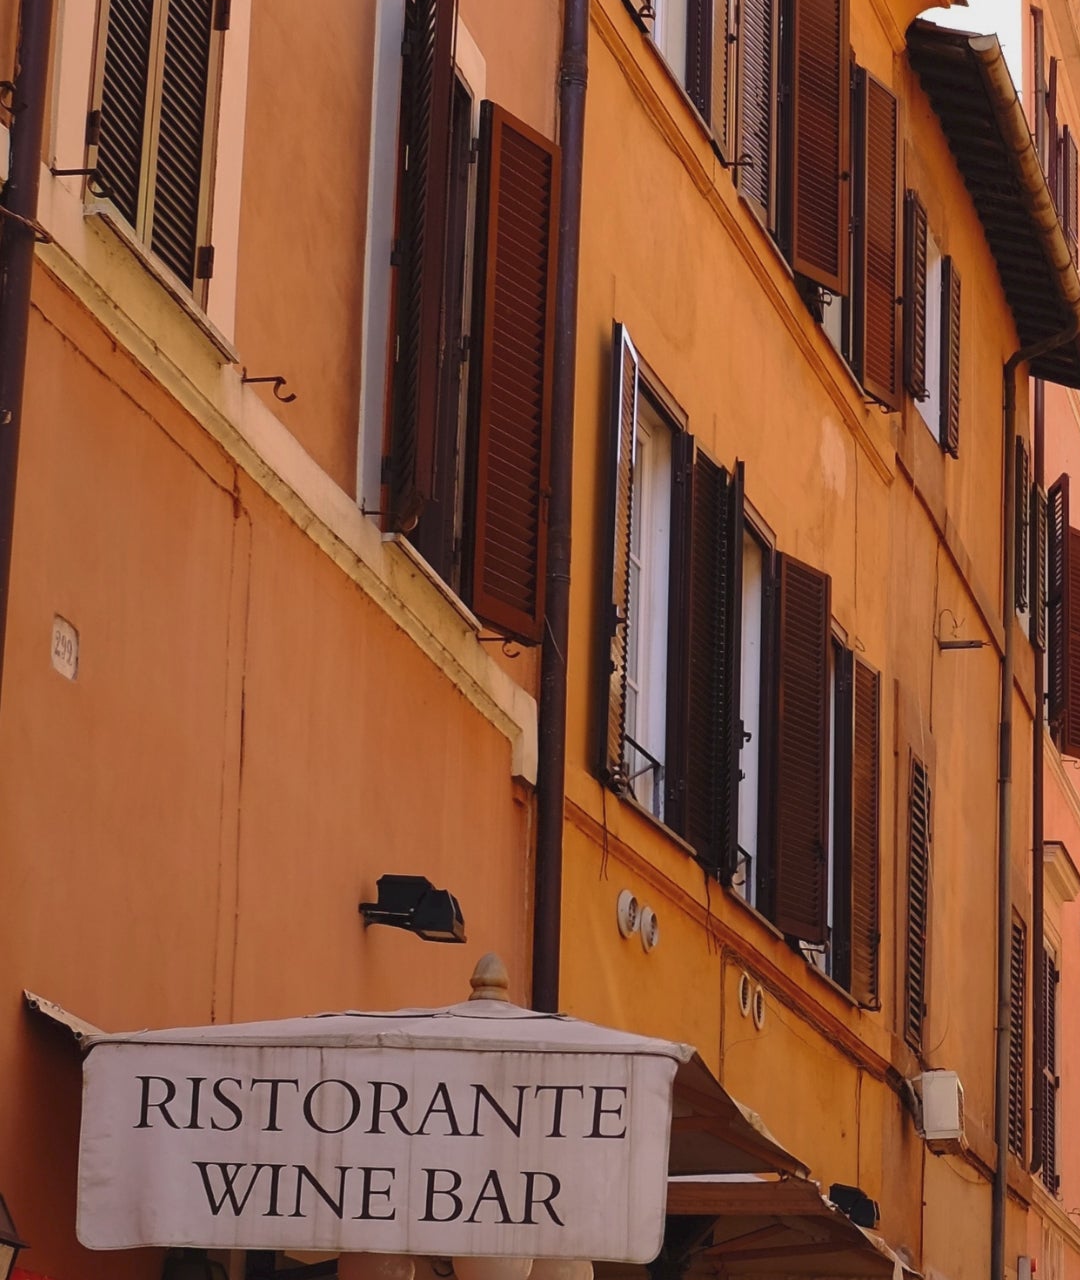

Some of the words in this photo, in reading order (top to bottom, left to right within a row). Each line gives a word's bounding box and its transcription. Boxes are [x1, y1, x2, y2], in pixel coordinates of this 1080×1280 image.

[133, 1075, 628, 1139] RISTORANTE
[192, 1161, 396, 1221] WINE
[418, 1168, 566, 1227] BAR
